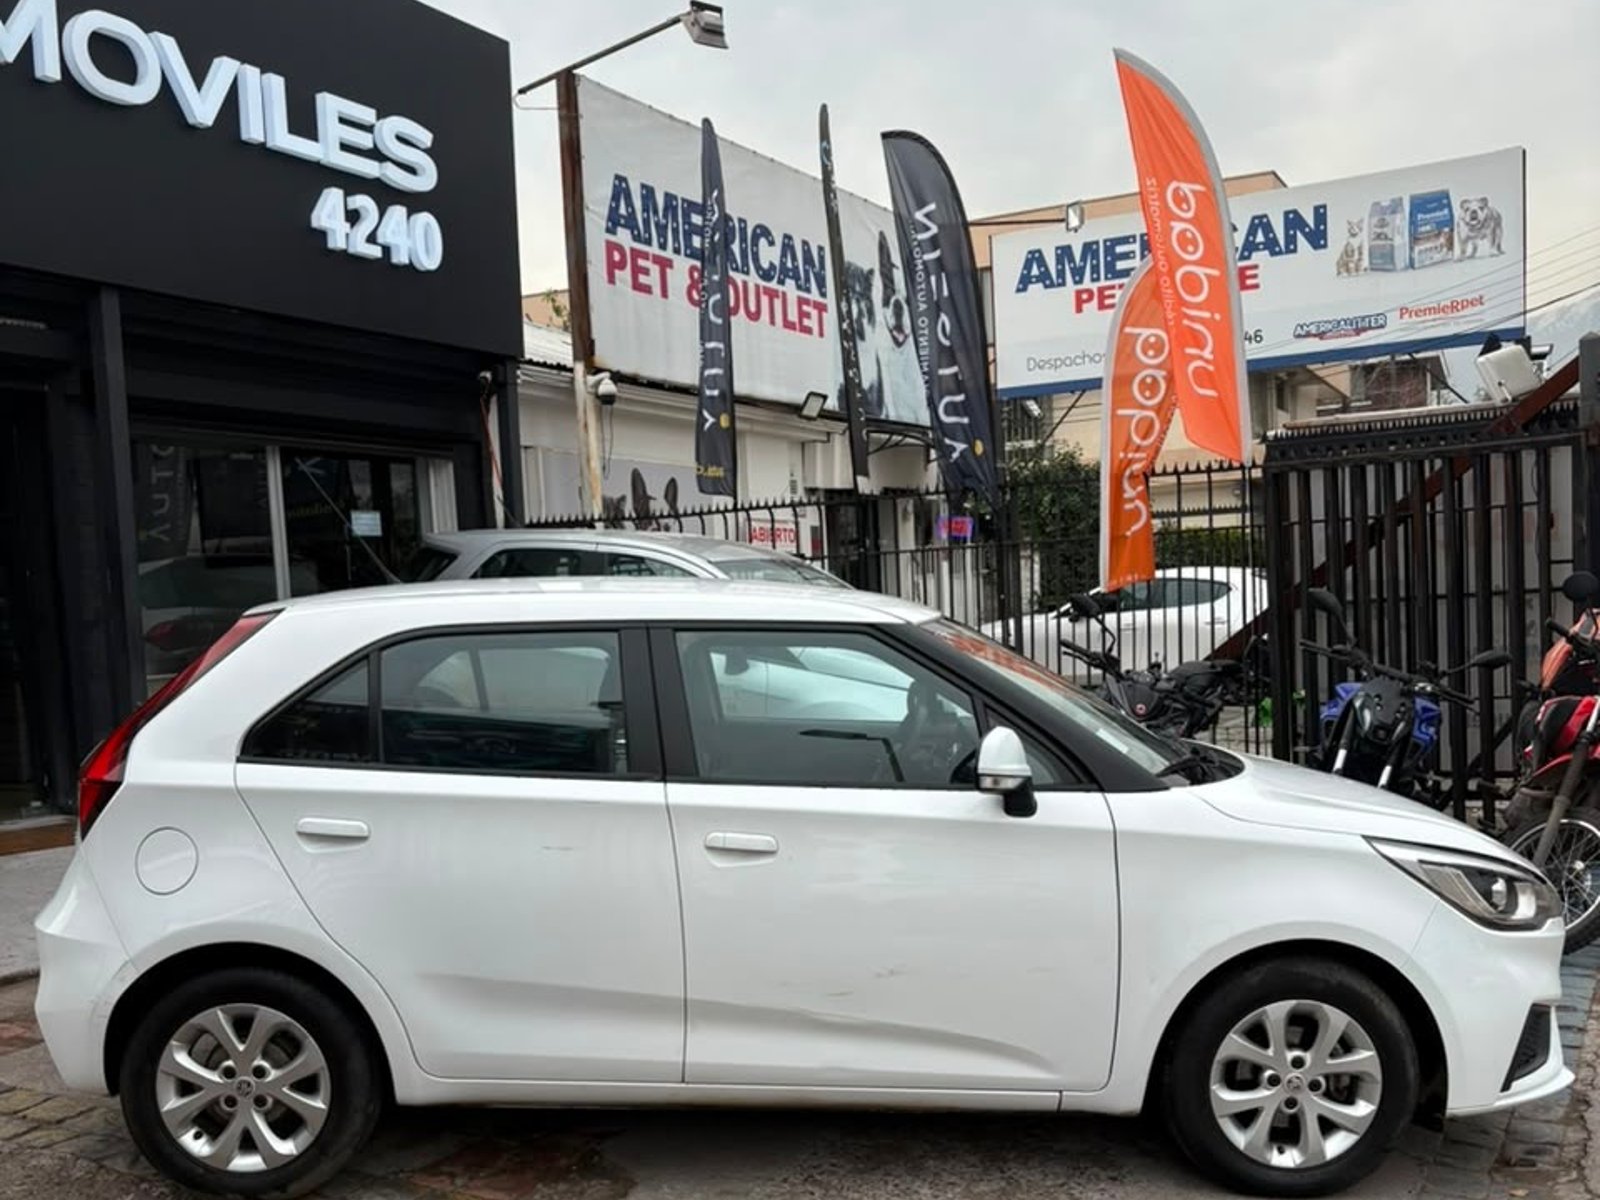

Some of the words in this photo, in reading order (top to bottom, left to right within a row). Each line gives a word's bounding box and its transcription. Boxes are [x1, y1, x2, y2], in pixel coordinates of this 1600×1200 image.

[310, 187, 443, 272] 4240
[605, 239, 674, 300] PET
[1074, 284, 1126, 314] PE
[1026, 350, 1106, 373] Despacho
